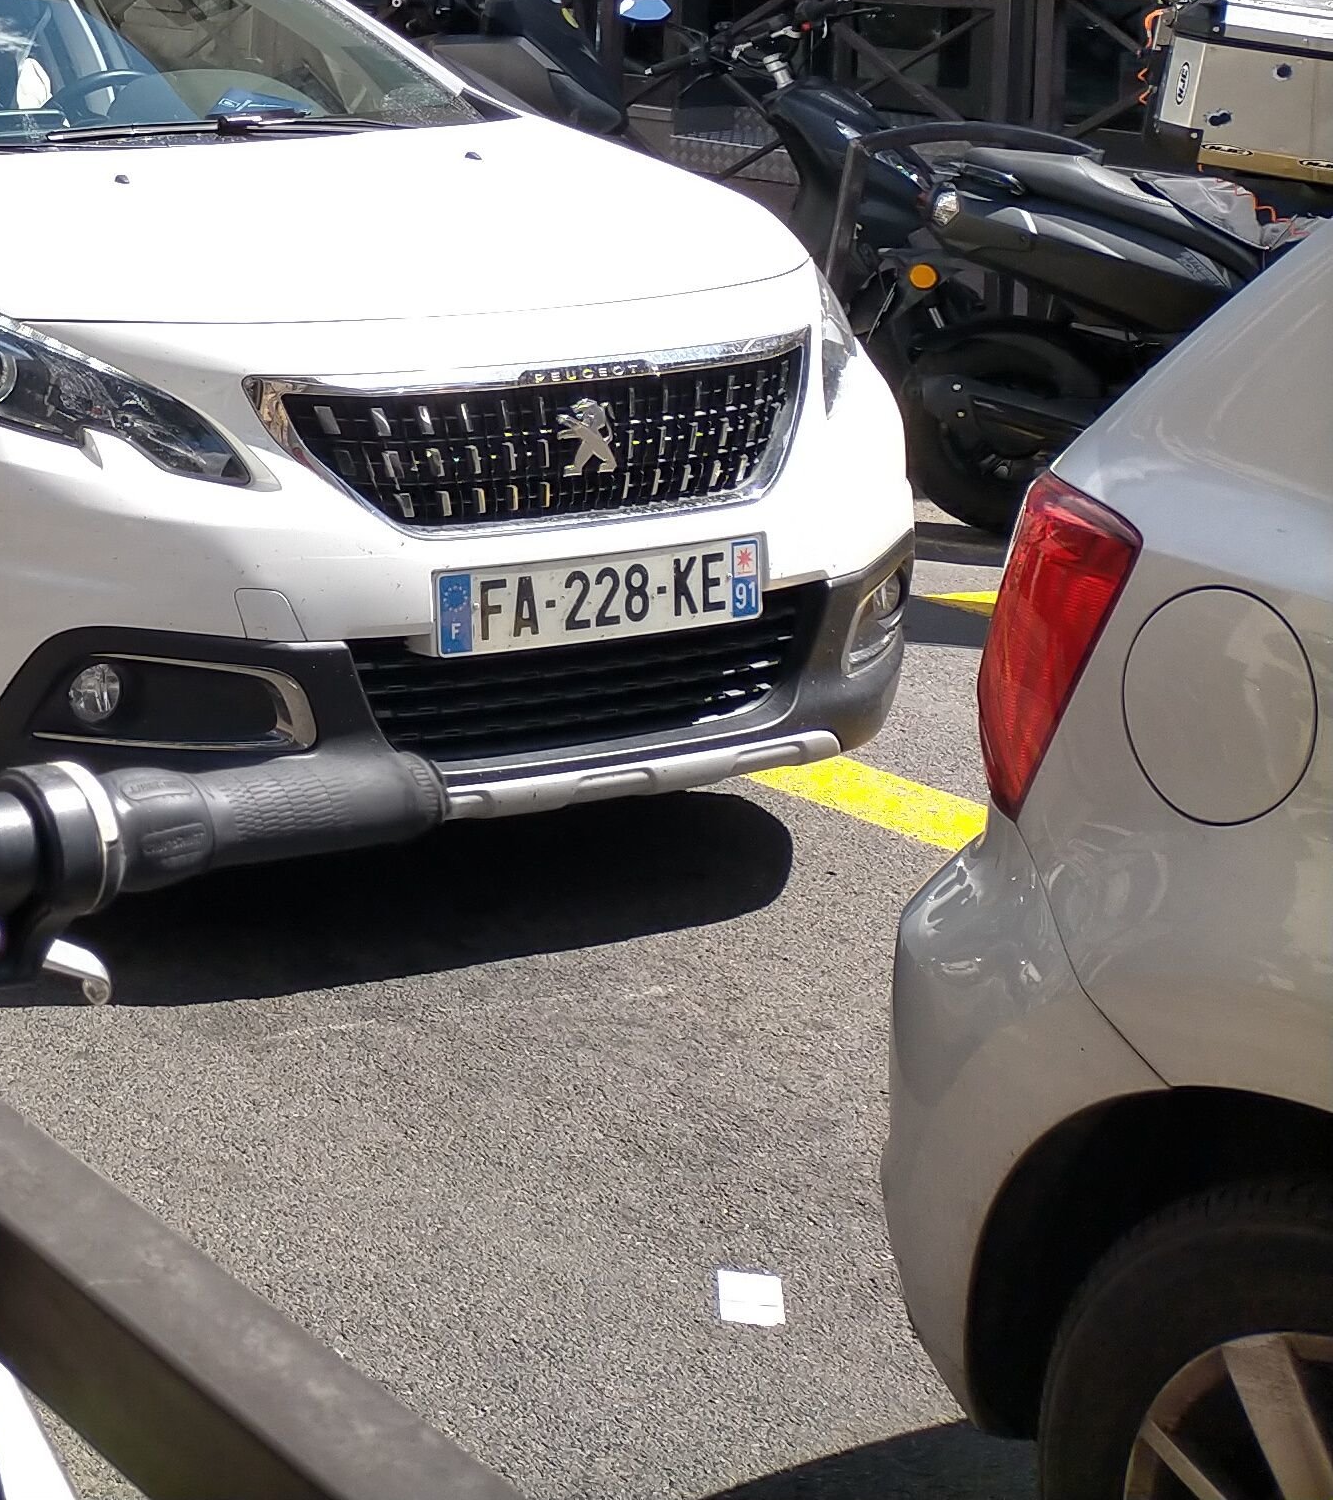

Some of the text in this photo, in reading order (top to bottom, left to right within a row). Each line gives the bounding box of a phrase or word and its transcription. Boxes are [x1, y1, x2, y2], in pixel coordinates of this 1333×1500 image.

[534, 364, 638, 383] PEUGEOT
[480, 551, 727, 641] FA-228-KE
[734, 582, 758, 610] 91
[450, 622, 461, 641] F
